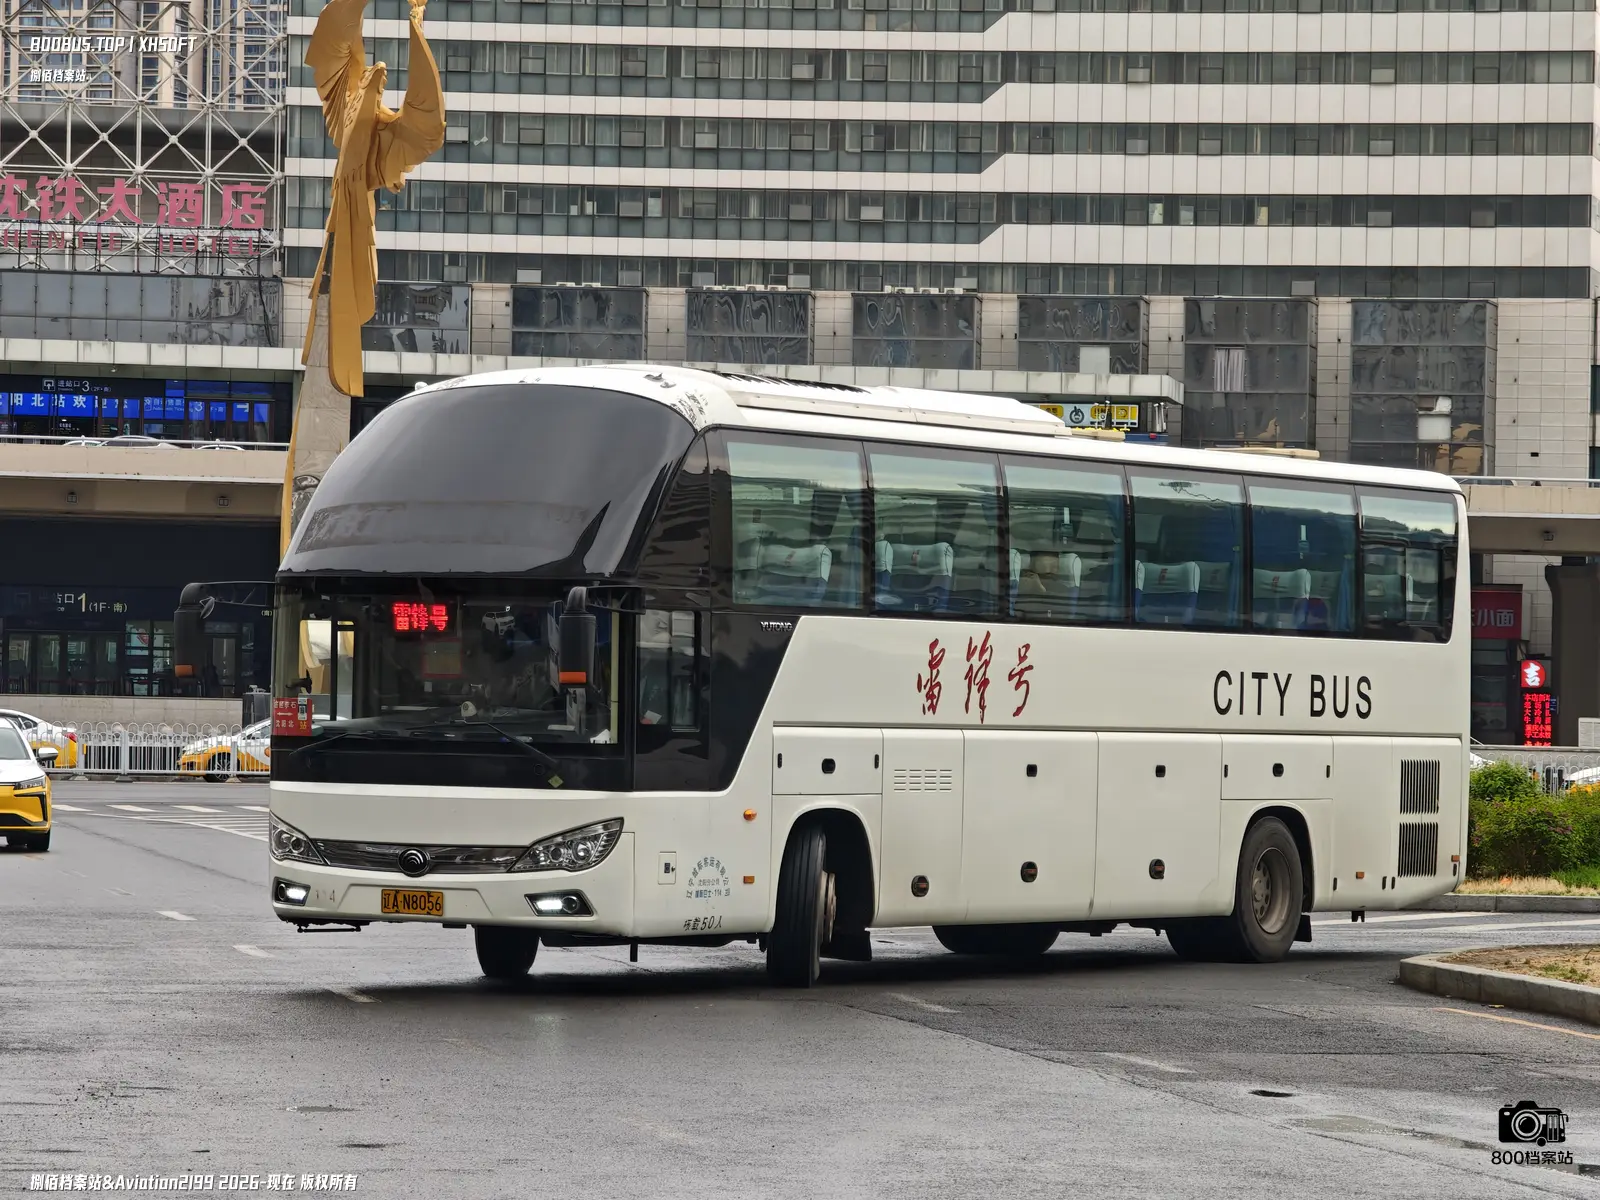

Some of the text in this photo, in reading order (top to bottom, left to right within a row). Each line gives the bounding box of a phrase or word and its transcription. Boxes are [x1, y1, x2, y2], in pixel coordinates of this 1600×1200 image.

[158, 233, 261, 255] HOTEL
[81, 380, 90, 392] 3
[77, 592, 87, 612] 1
[394, 603, 449, 630] 雷锋号
[760, 621, 792, 631] YUTONG
[1471, 609, 1514, 627] 小面
[916, 630, 1034, 724] 雷锋号
[1213, 669, 1373, 719] CITY BUS
